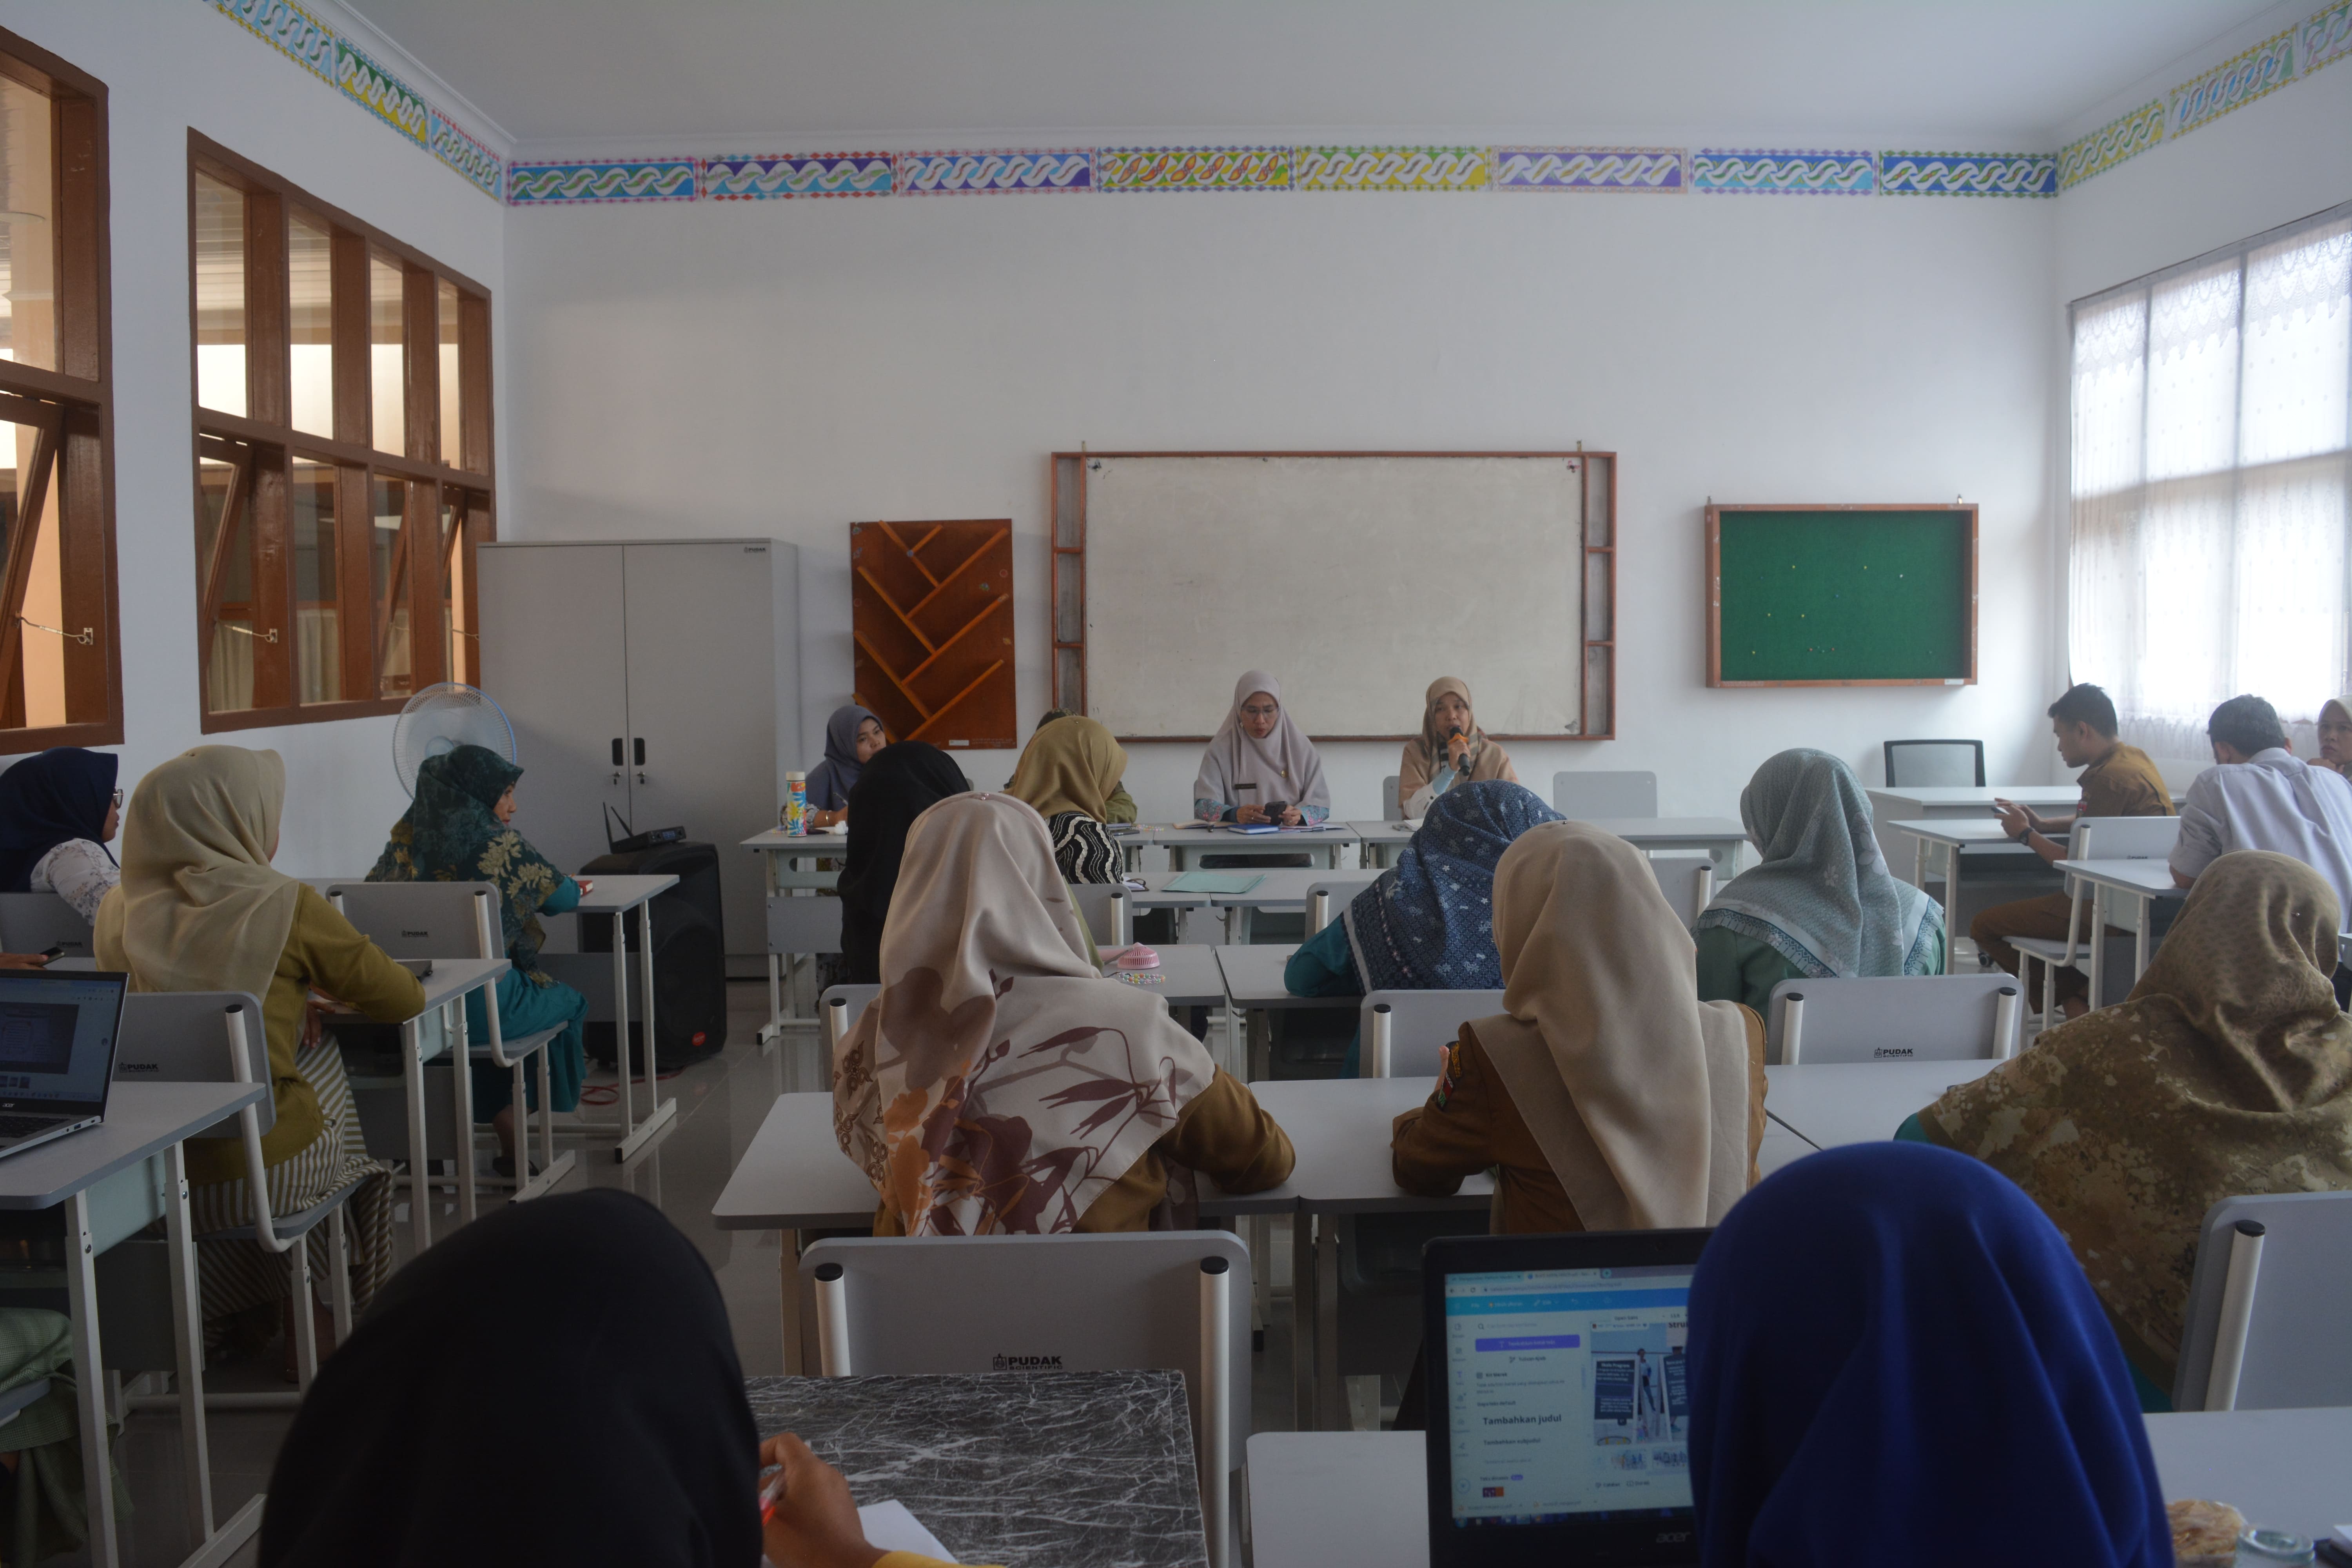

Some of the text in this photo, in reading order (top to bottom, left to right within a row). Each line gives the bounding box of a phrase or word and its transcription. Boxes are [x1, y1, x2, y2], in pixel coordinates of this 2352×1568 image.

[1009, 1356, 1062, 1365] PUDAK
[1483, 1414, 1562, 1425] Tambahkan judul
[1656, 1532, 1691, 1543] acer
